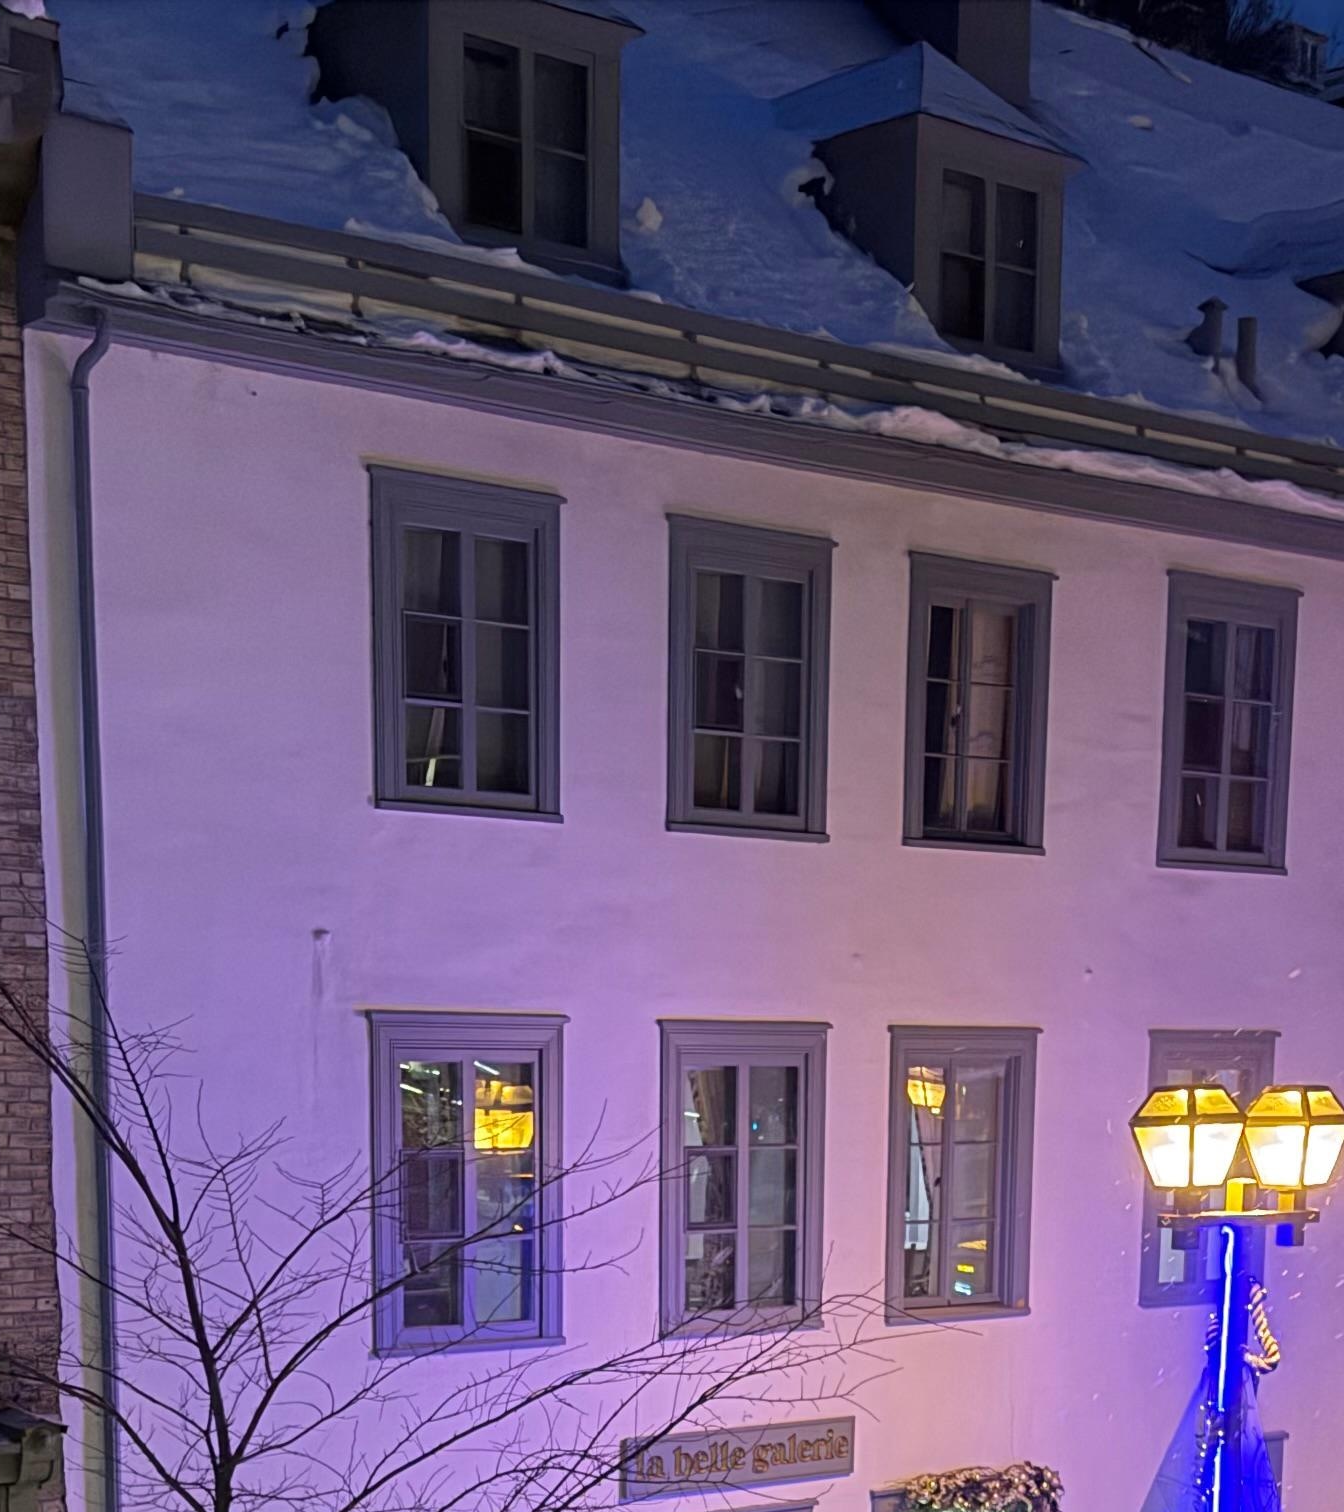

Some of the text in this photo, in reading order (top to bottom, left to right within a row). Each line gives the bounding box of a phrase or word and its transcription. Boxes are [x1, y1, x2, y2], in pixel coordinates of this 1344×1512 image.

[635, 1428, 850, 1481] la belle galerie
